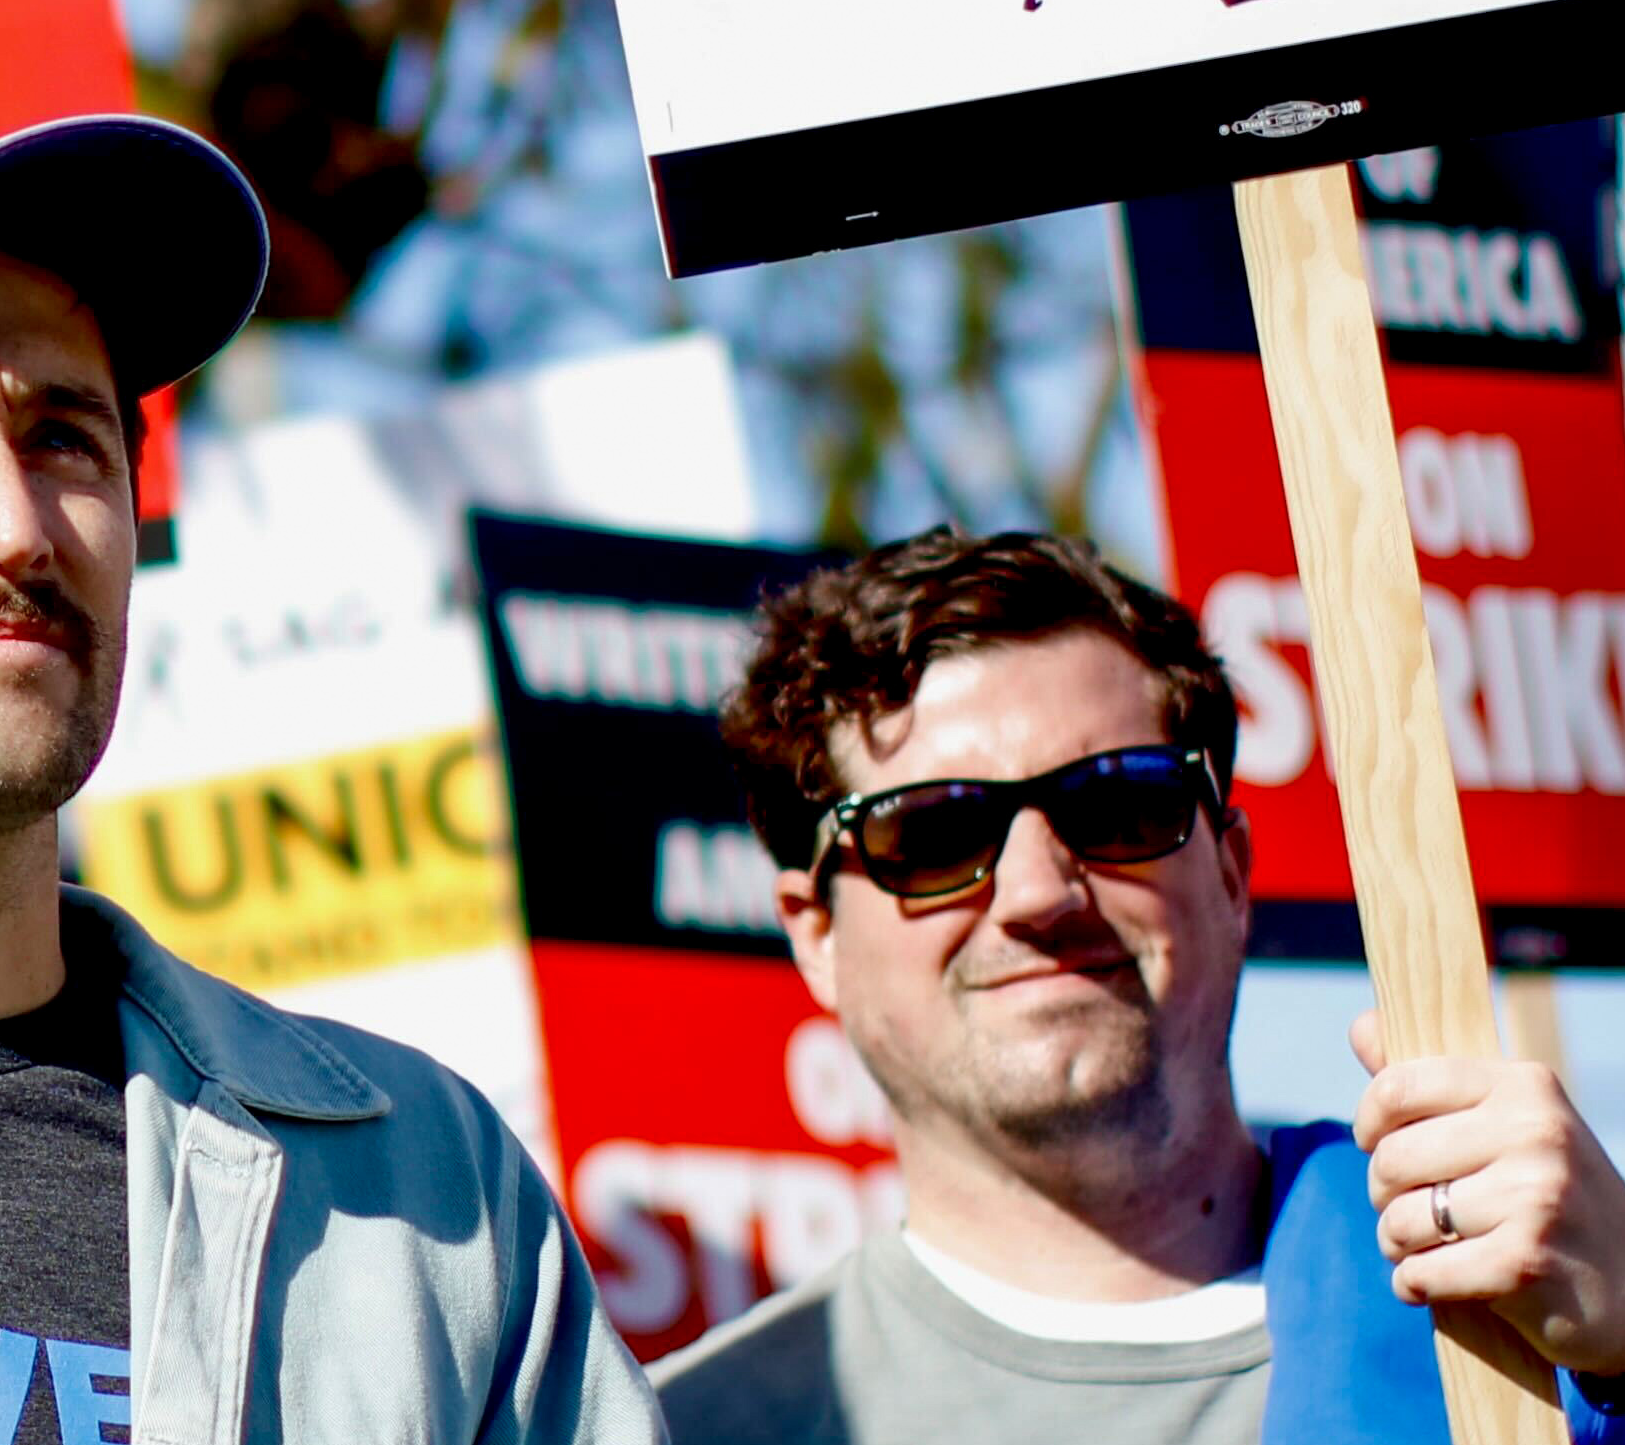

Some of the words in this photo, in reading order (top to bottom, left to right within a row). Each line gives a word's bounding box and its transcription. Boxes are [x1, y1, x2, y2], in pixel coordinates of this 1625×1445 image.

[1360, 218, 1583, 341] ERICA
[1401, 425, 1533, 560] ON
[502, 593, 755, 711] WRIT
[142, 739, 492, 914] UNIO
